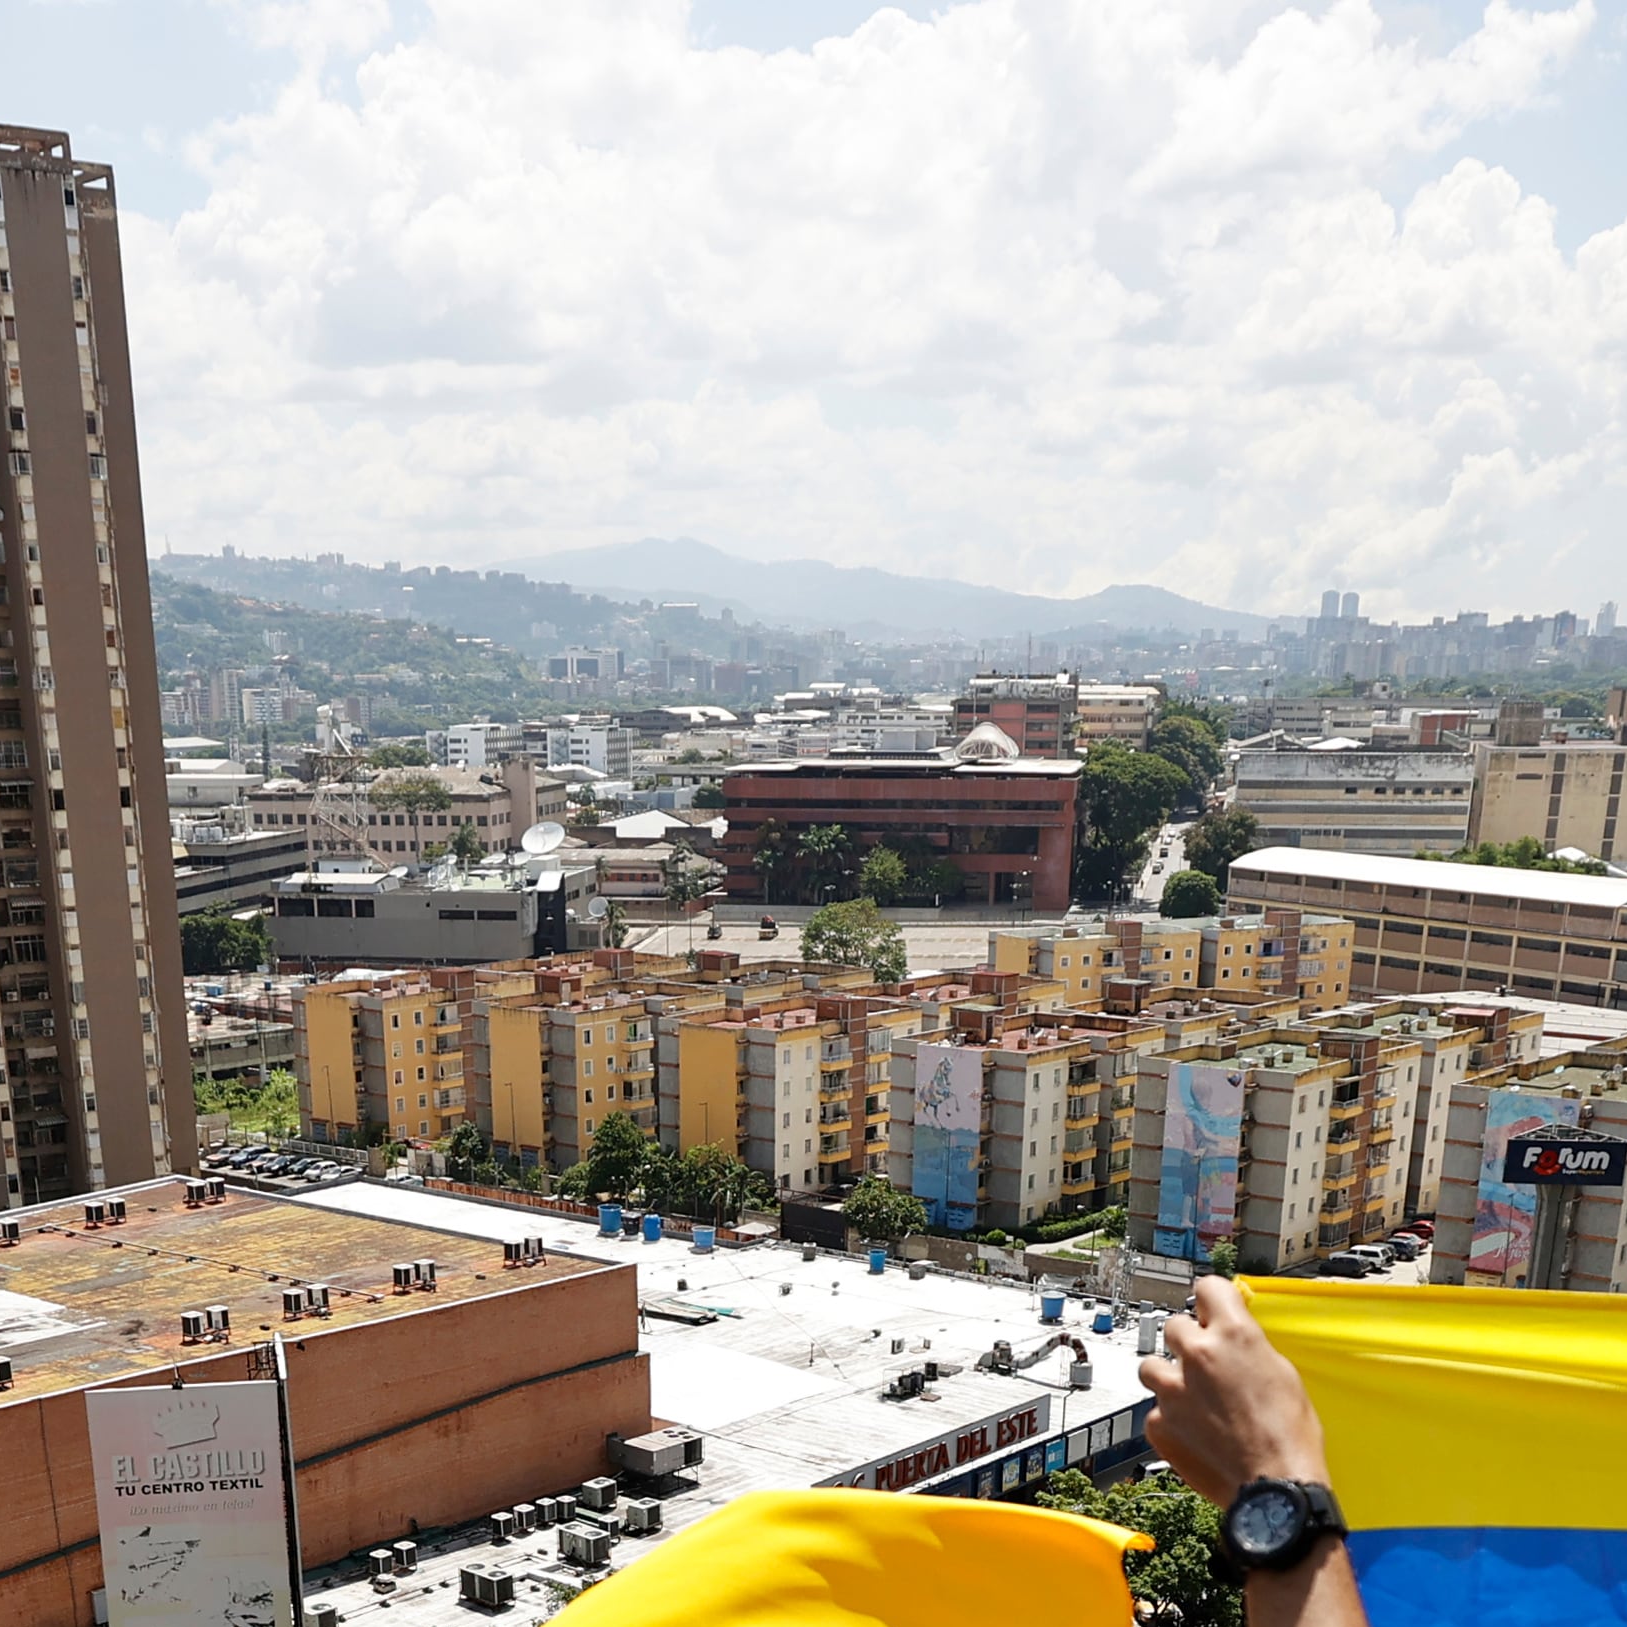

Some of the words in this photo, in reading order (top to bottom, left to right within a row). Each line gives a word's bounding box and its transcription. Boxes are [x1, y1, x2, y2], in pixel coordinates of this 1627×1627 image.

[1523, 1146, 1610, 1174] Forum
[876, 1441, 950, 1490] PUERTA
[956, 1424, 992, 1464] DEL
[997, 1406, 1038, 1448] ESTE
[114, 1456, 141, 1484] EL
[149, 1449, 266, 1482] CASTILLO
[115, 1486, 136, 1497] TU
[141, 1481, 204, 1495] CENTRO
[210, 1478, 264, 1491] TEXTIL
